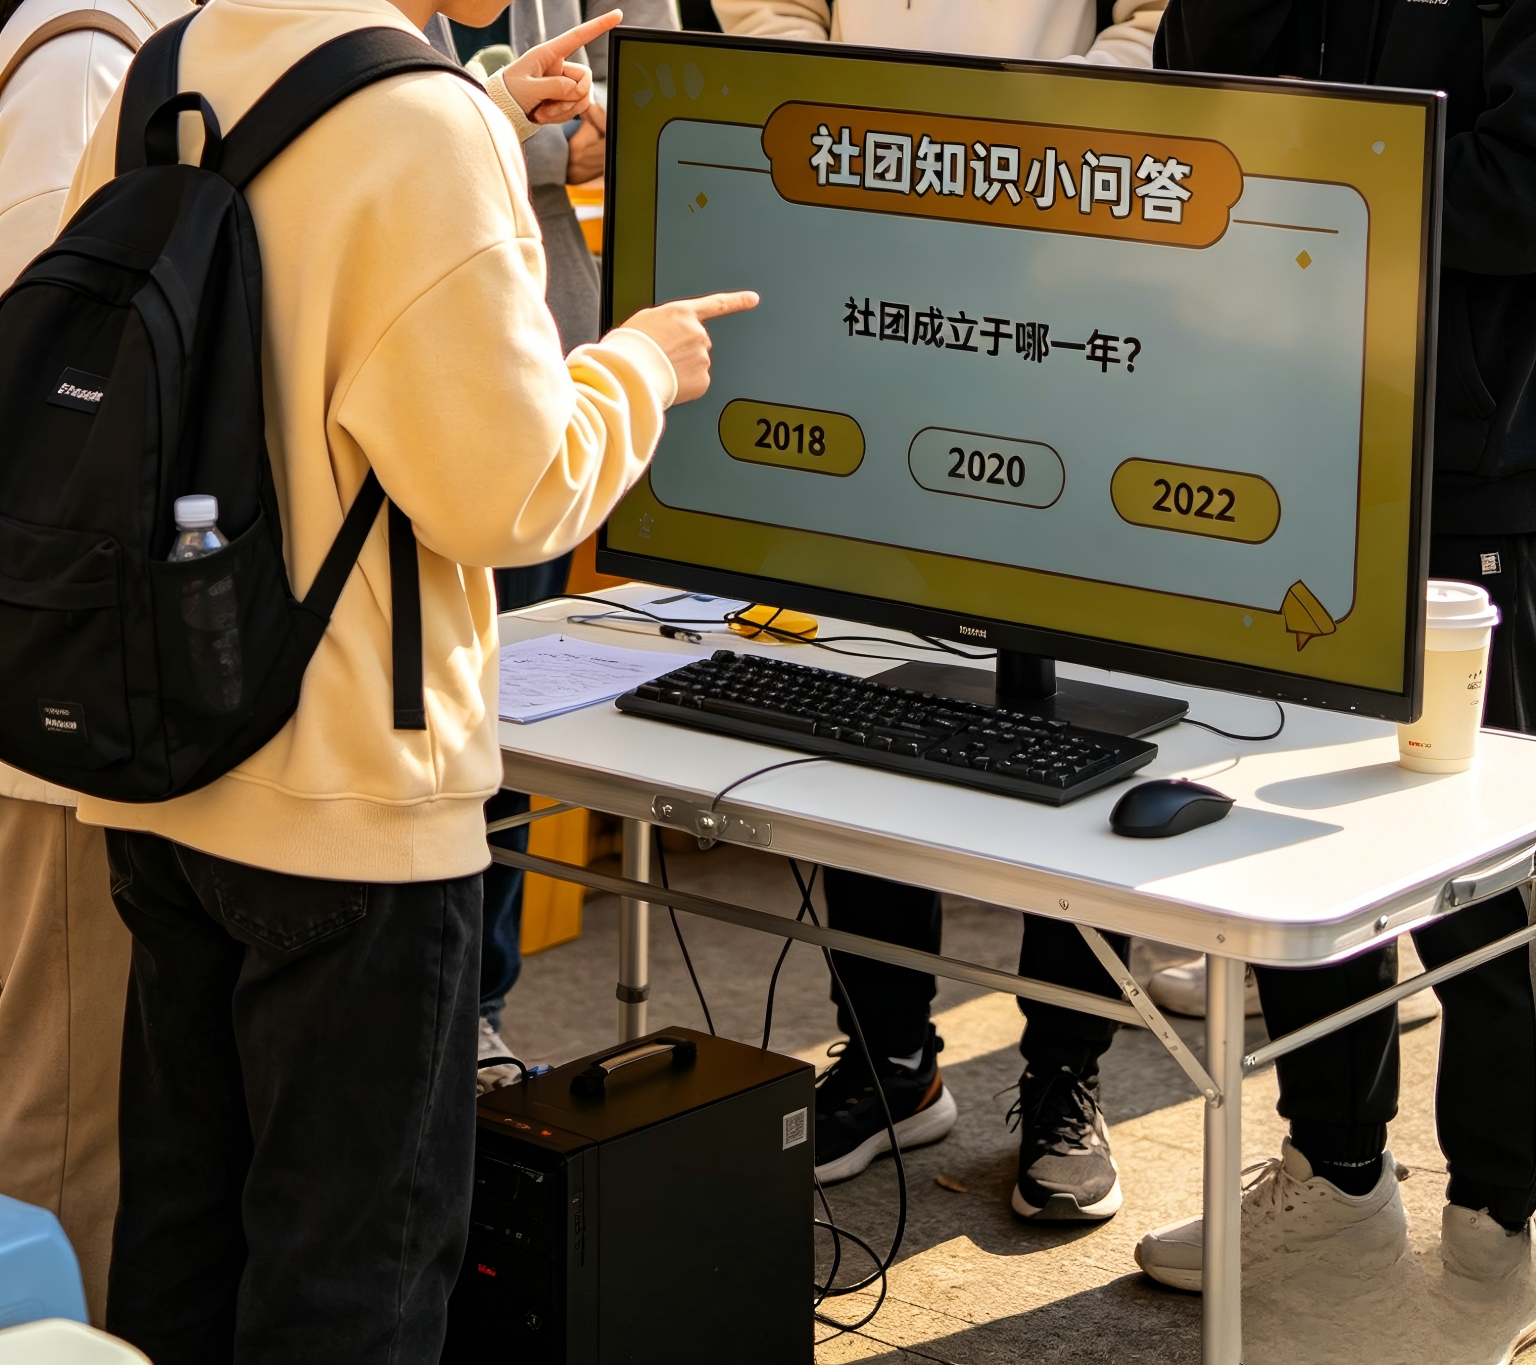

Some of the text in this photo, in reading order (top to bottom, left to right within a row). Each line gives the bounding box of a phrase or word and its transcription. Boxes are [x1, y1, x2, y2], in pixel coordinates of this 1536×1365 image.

[810, 124, 1193, 225] 社团知识小问答
[754, 417, 826, 457] 2018
[947, 447, 1026, 488] 2020
[1151, 478, 1236, 523] 2022
